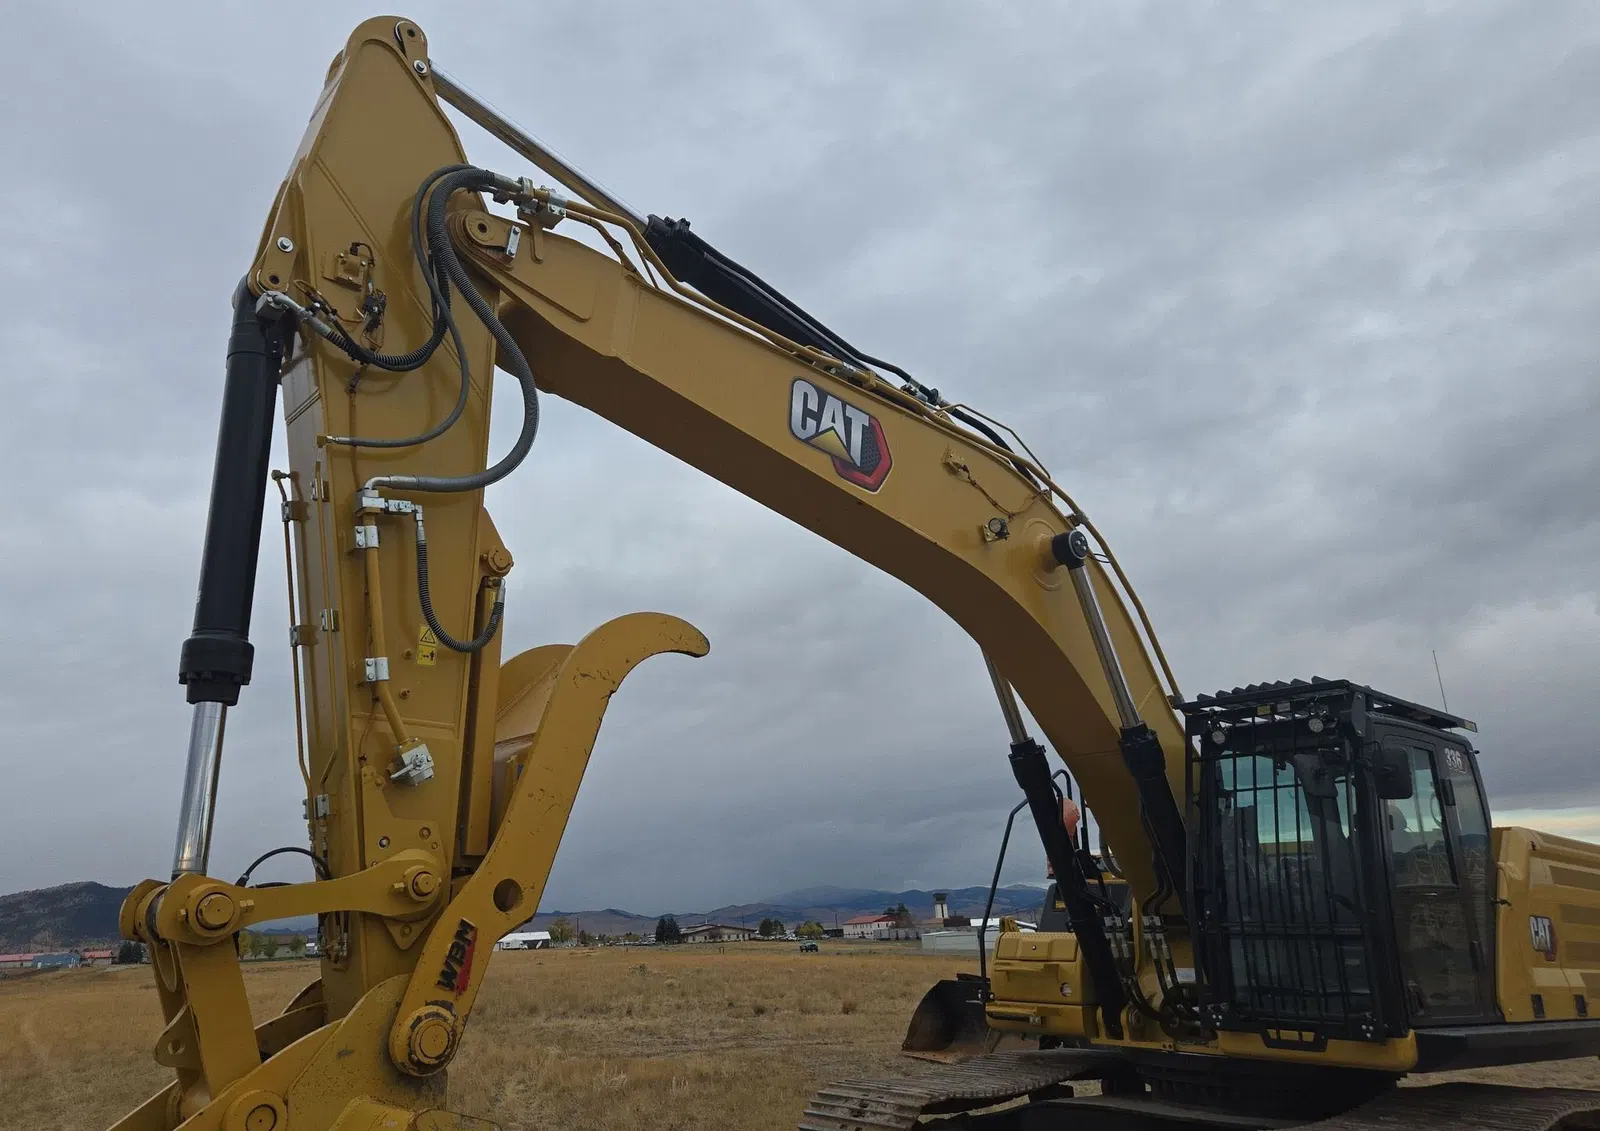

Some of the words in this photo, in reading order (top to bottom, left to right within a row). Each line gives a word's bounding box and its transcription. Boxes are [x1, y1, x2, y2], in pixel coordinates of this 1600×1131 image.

[791, 379, 870, 467] CAT
[1444, 747, 1463, 770] 336
[435, 919, 474, 991] WBM
[1529, 915, 1551, 950] CAT
